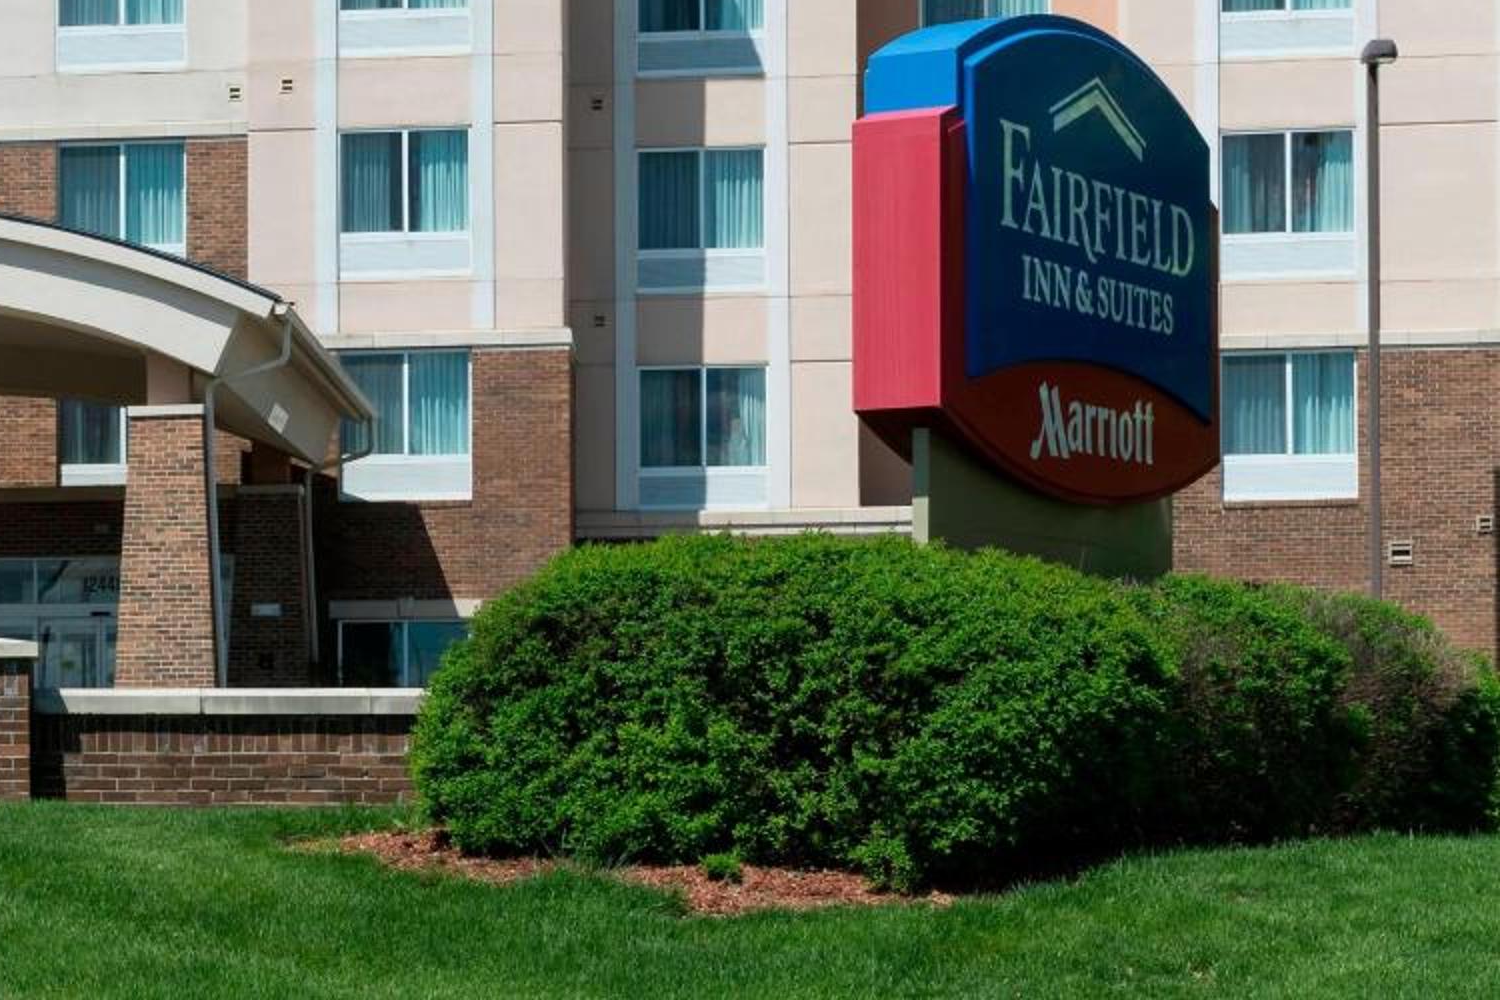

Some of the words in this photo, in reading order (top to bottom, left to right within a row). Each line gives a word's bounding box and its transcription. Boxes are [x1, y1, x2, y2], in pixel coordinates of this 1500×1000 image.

[1000, 119, 1195, 277] FAIRFIELD
[1021, 254, 1072, 310] INN
[1075, 269, 1095, 316] &
[1098, 278, 1174, 335] SUITES
[1030, 381, 1155, 465] Marriott
